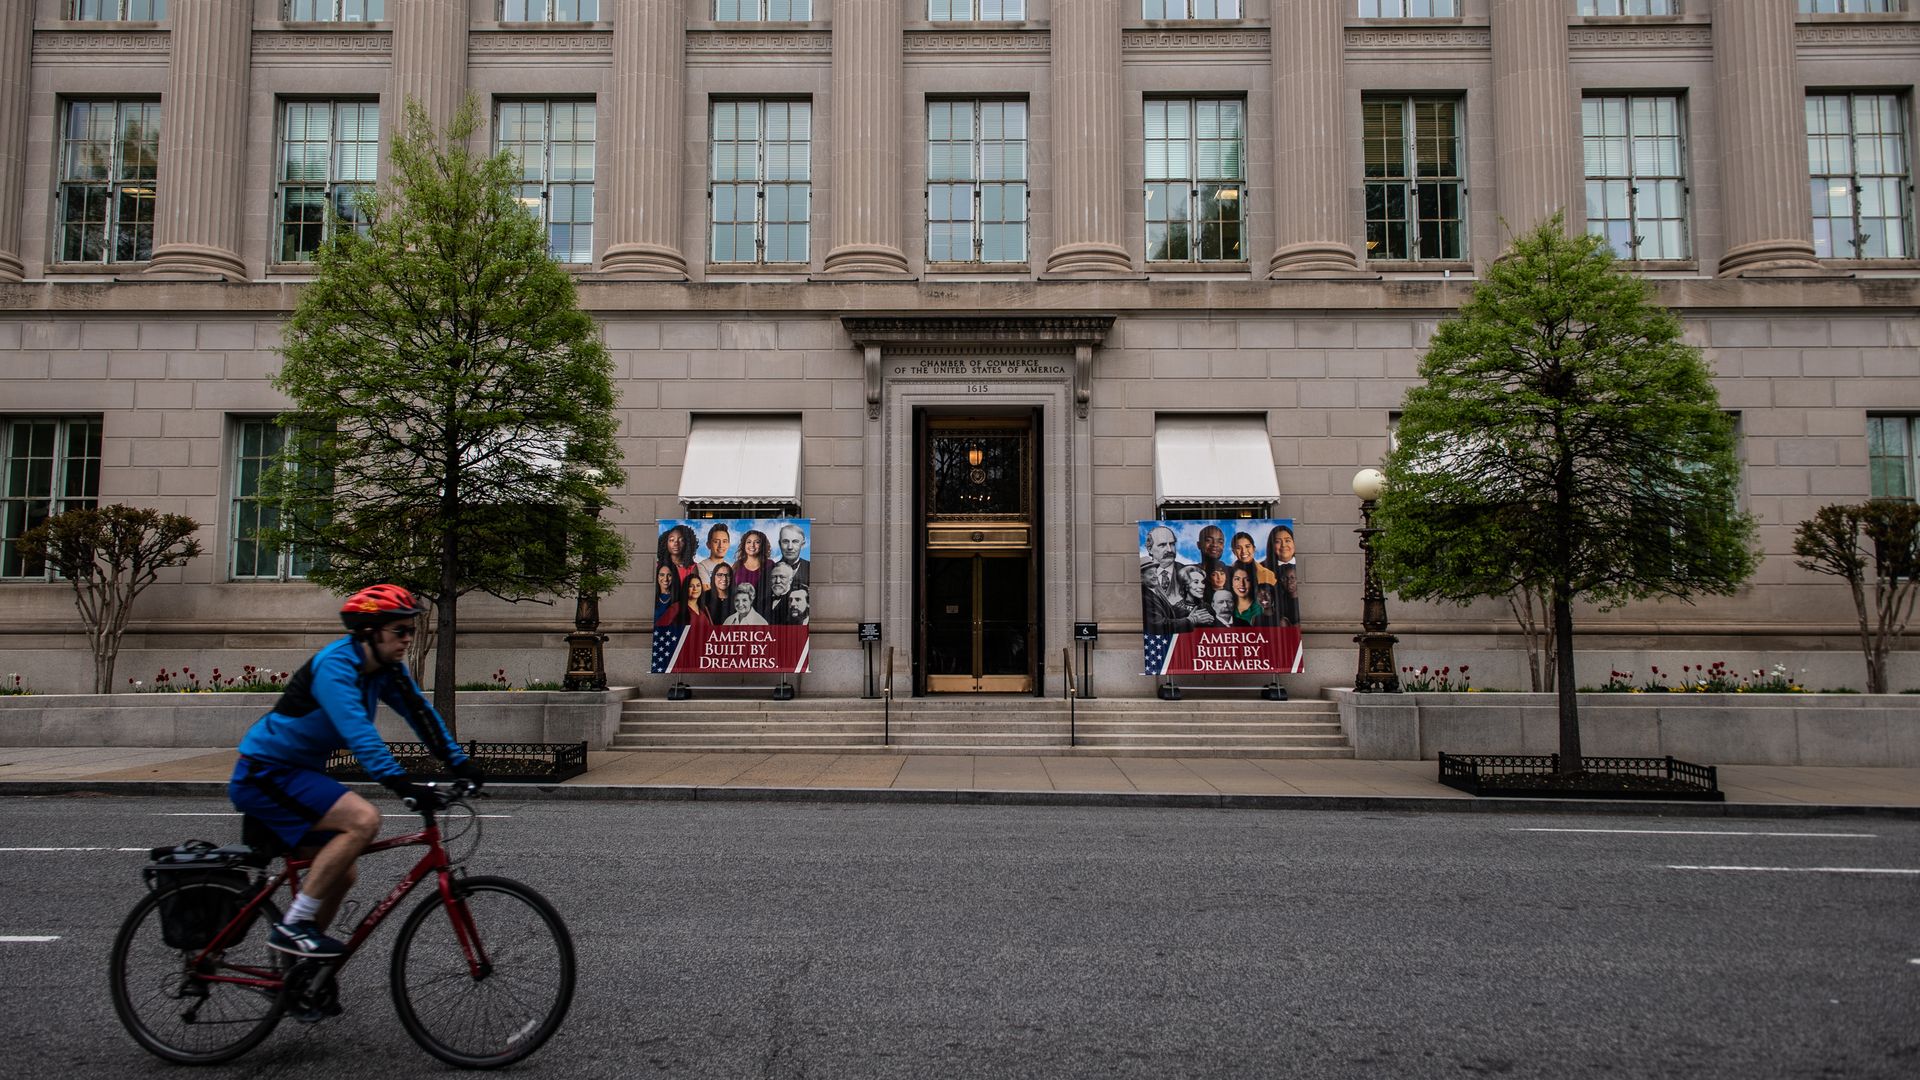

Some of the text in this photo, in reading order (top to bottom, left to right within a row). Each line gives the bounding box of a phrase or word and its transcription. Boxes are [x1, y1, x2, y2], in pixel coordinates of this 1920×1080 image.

[967, 385, 988, 393] 1615
[707, 630, 776, 642] AMERICA.
[1200, 632, 1268, 643] AMERICA.
[705, 643, 768, 655] BUILT BY
[1197, 645, 1260, 657] BUILT BY
[700, 657, 779, 669] DREAMERS.
[1193, 659, 1274, 671] DREAMERS.
